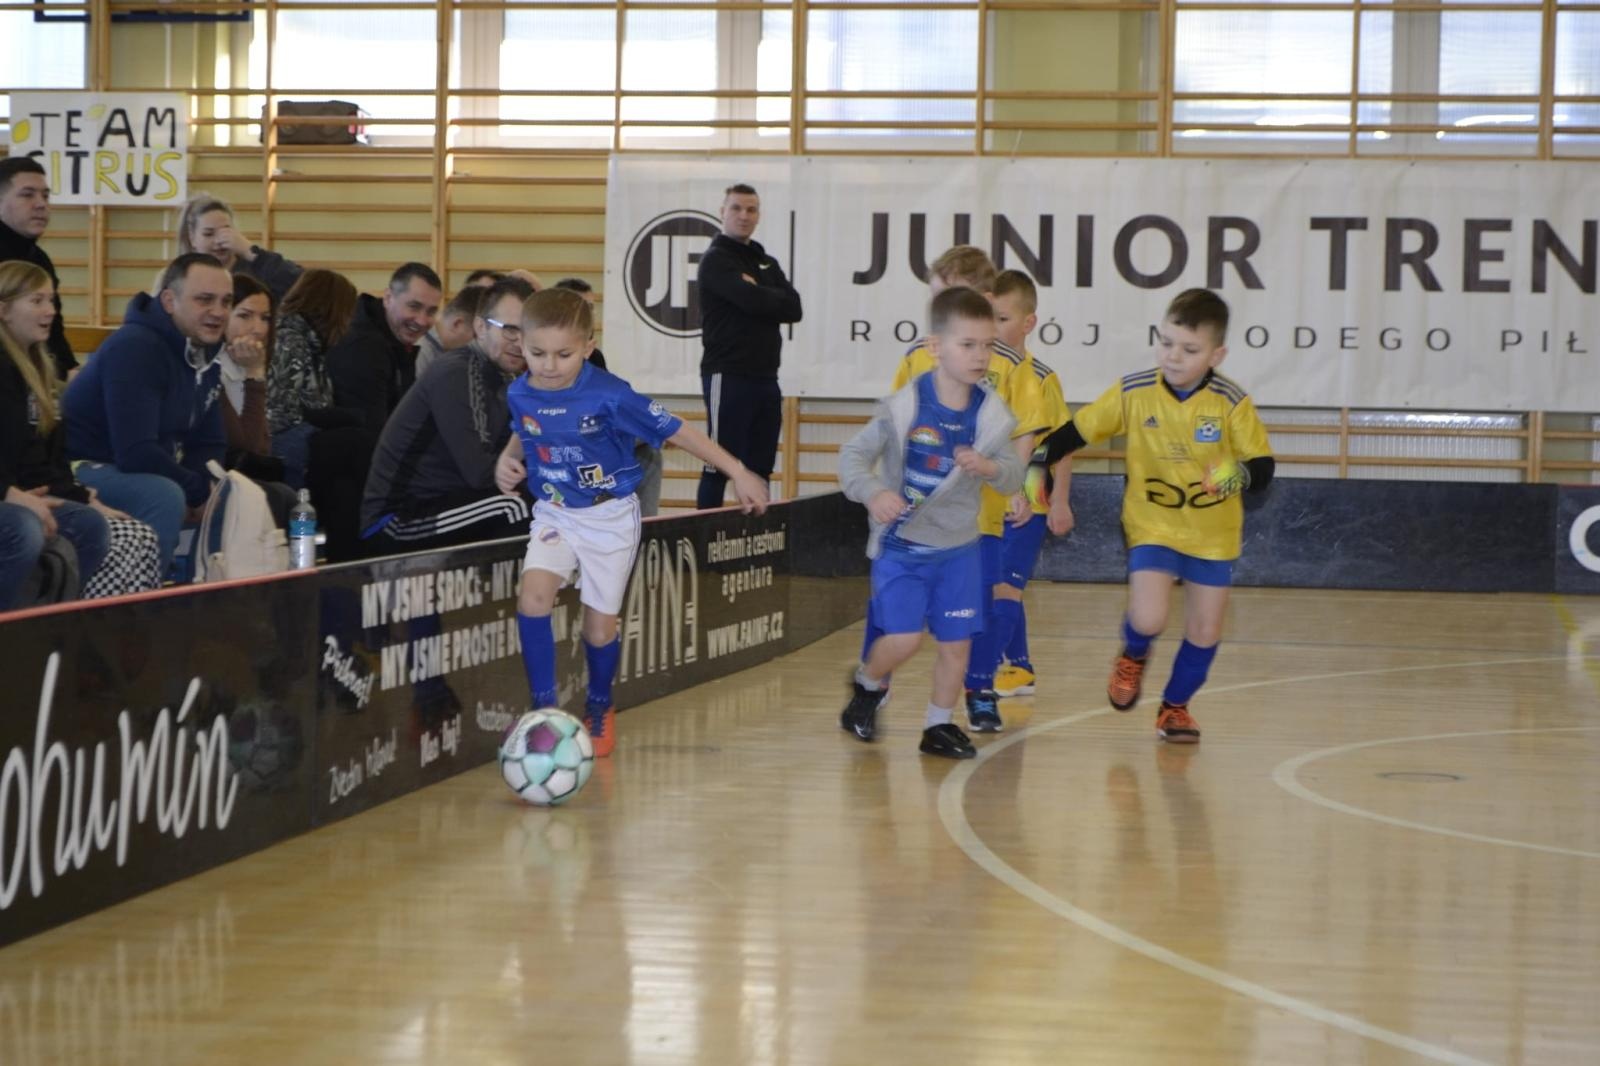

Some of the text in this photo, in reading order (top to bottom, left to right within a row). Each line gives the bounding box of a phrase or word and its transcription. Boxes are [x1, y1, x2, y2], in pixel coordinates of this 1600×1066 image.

[30, 107, 176, 148] TEAM
[27, 150, 182, 199] ITRUS
[852, 212, 1598, 294] JUNIOR TREN
[851, 317, 1101, 346] ROÓJ
[1501, 329, 1588, 353] PIŁ
[361, 580, 391, 629] MY
[391, 573, 435, 623] JSME
[492, 560, 515, 601] MY
[721, 565, 773, 603] agentura
[381, 642, 409, 690] MY
[409, 632, 450, 683] JSME
[452, 609, 505, 672] PROSTĚ
